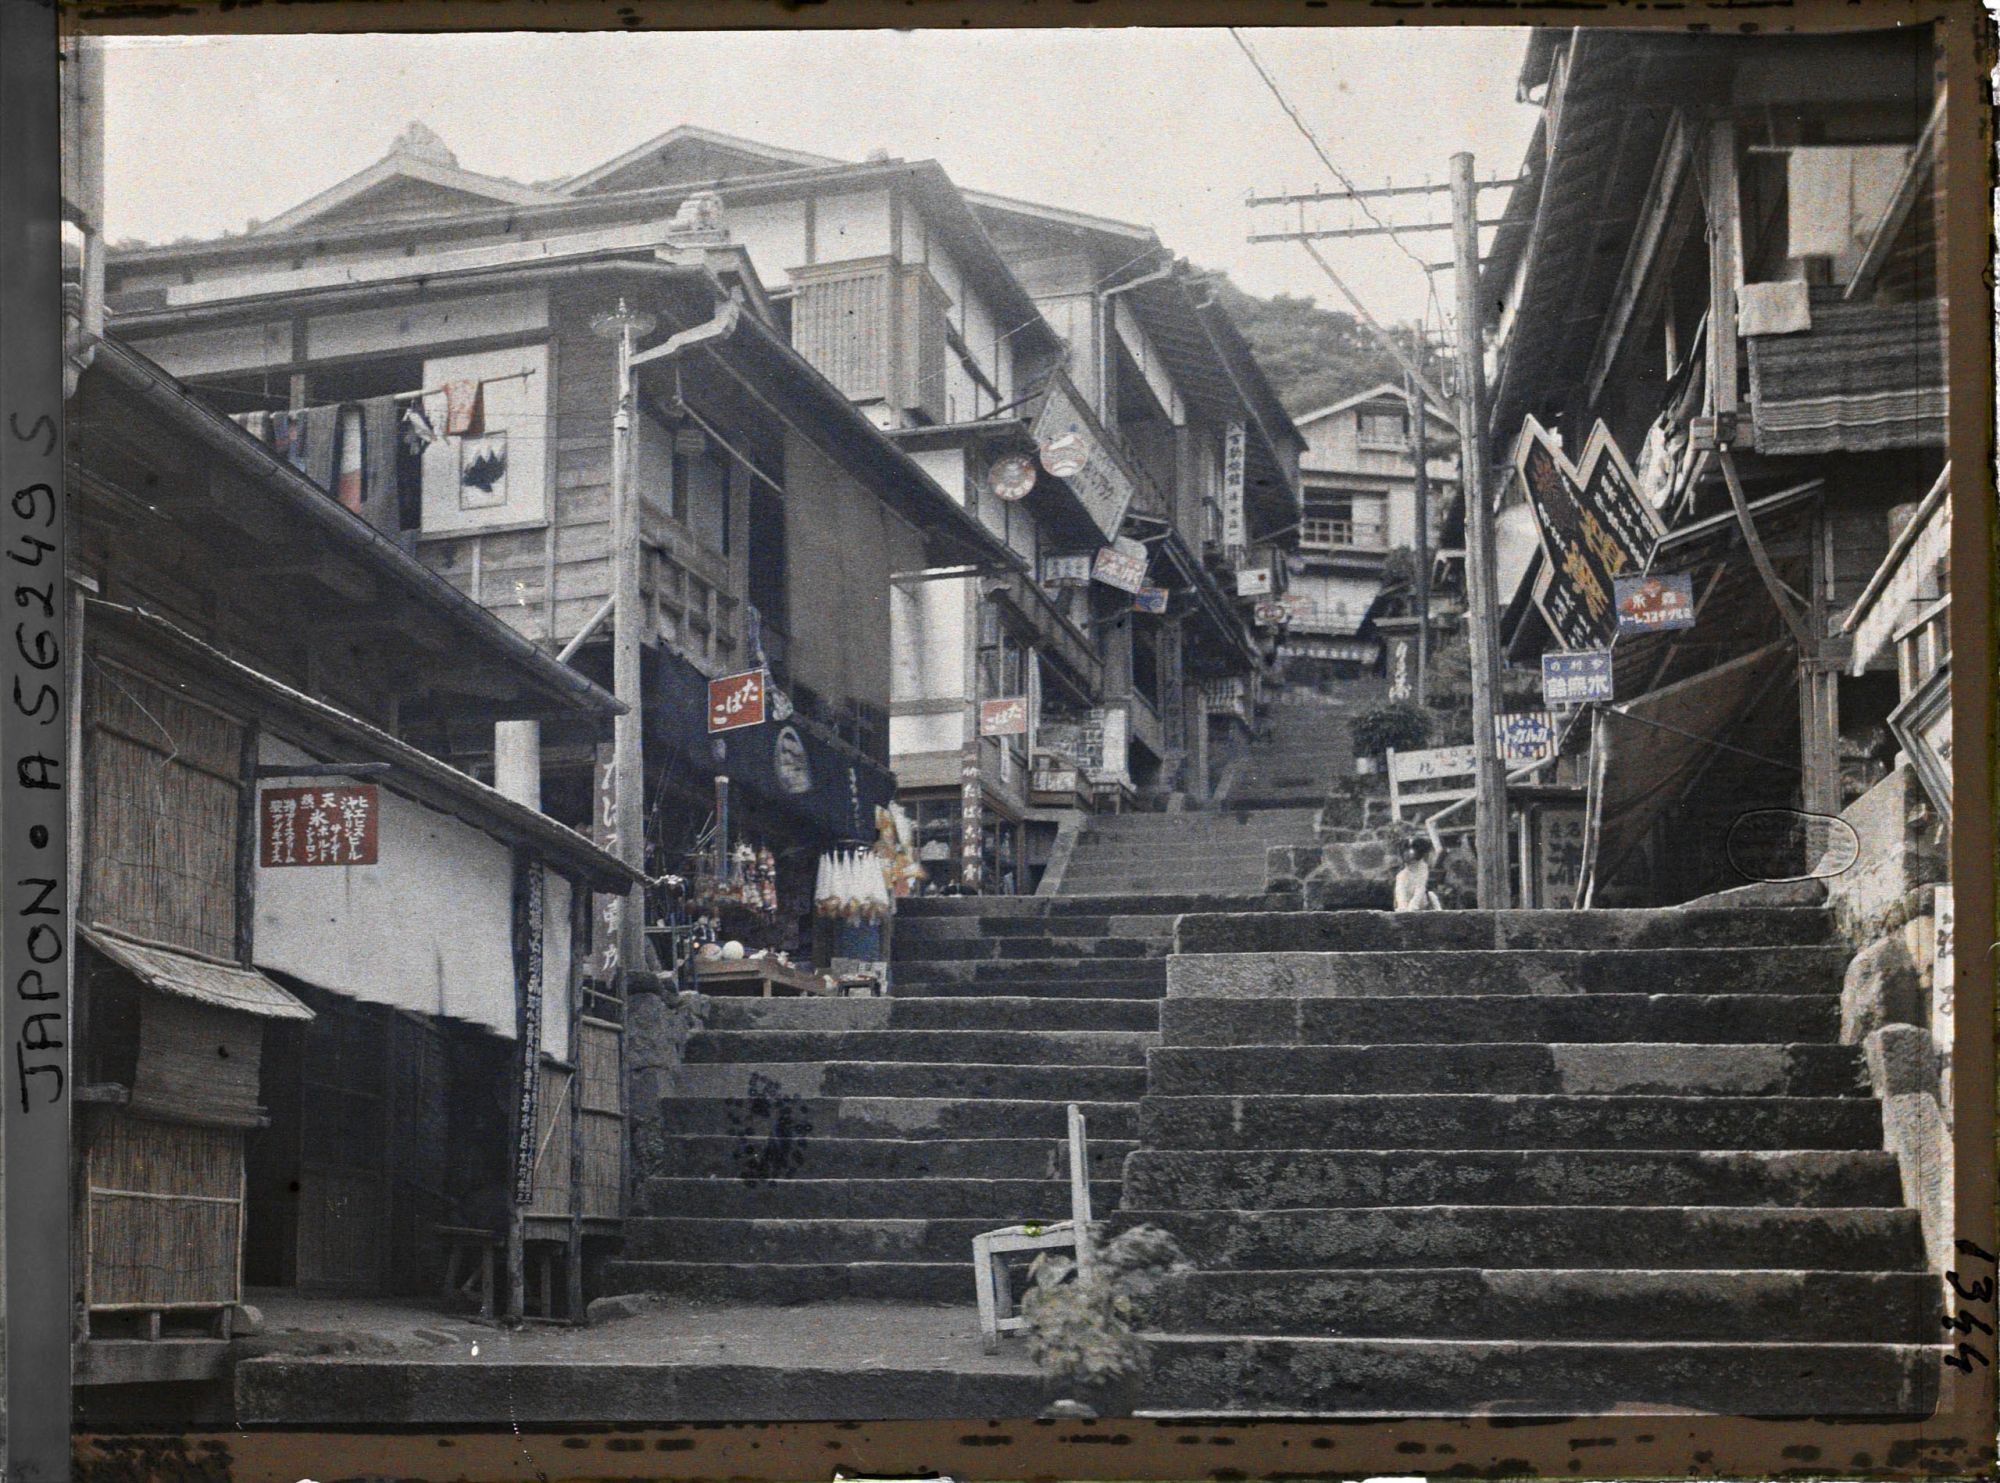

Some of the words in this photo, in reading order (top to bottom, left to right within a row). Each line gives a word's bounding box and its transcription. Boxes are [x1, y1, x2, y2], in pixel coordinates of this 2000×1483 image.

[713, 678, 759, 725] たばこ
[16, 878, 63, 1114] JAPON
[1941, 1239, 1997, 1374] 1344
